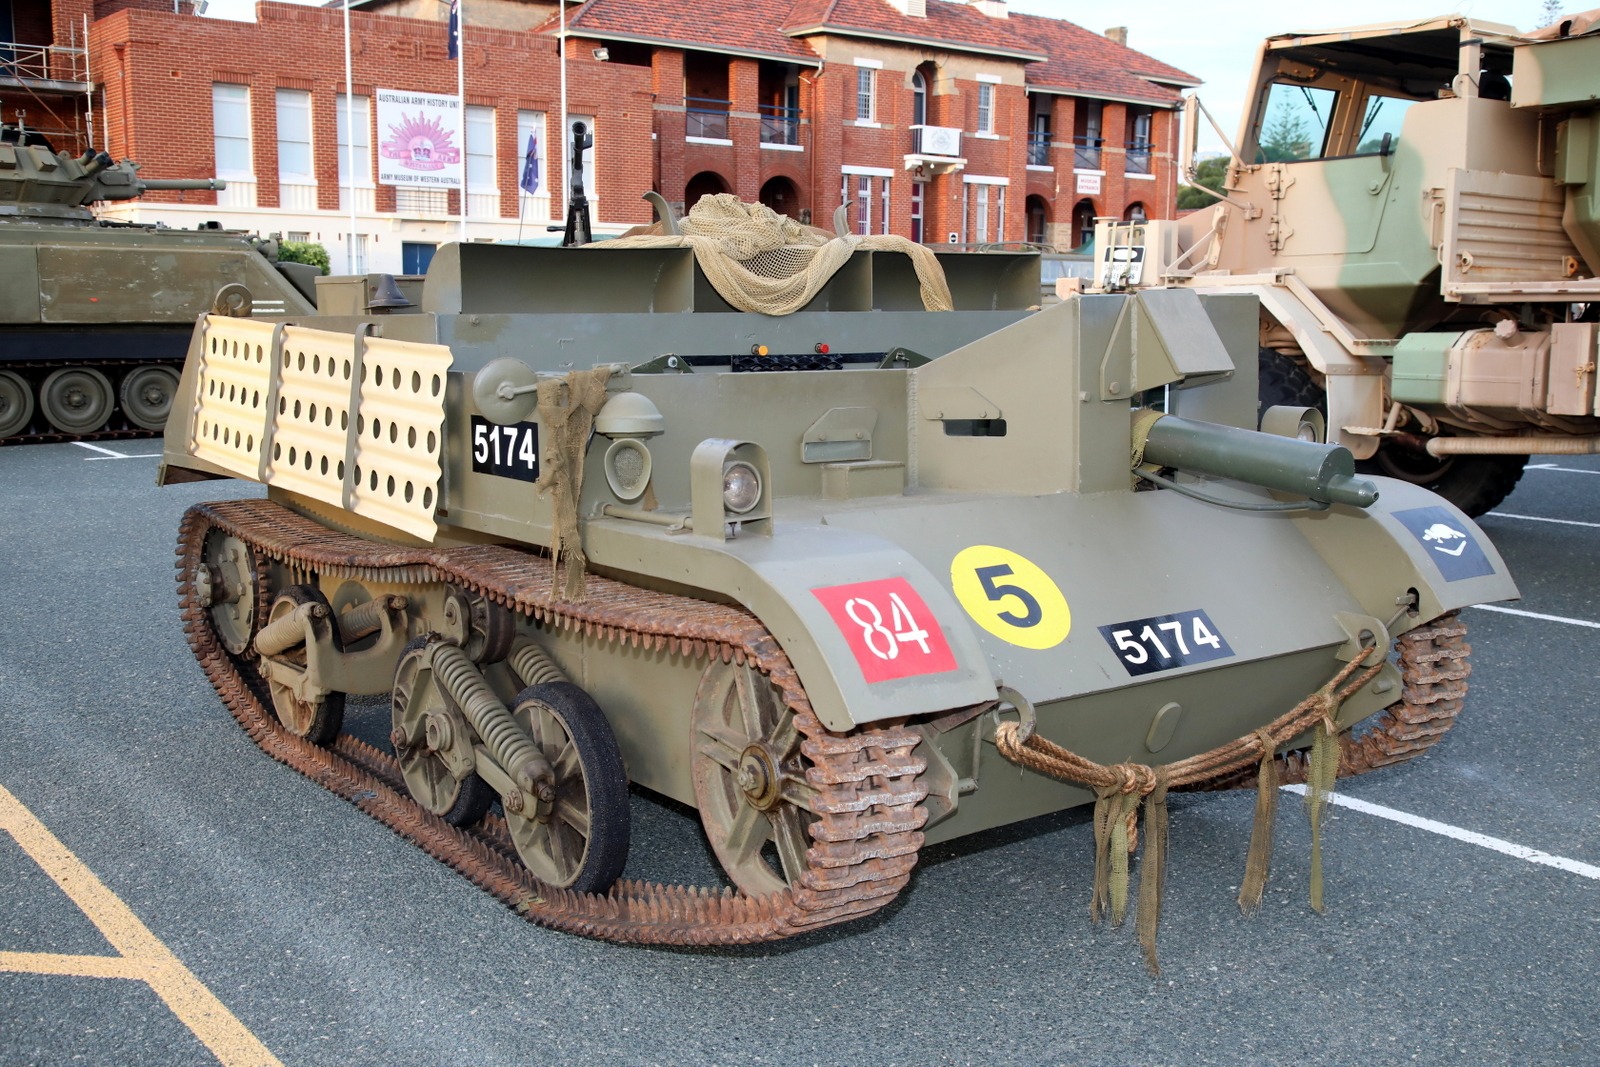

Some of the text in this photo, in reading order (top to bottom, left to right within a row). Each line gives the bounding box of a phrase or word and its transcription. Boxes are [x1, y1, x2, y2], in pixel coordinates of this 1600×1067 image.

[379, 94, 410, 104] AUSTRALIAN
[411, 96, 426, 106] ARMY
[427, 99, 448, 108] HISTORY
[394, 174, 413, 182] MUSEUM
[440, 177, 461, 185] AUSTRALI
[474, 424, 536, 470] 5174
[974, 563, 1042, 629] 5
[845, 592, 930, 661] 84
[1111, 616, 1221, 665] 5174
